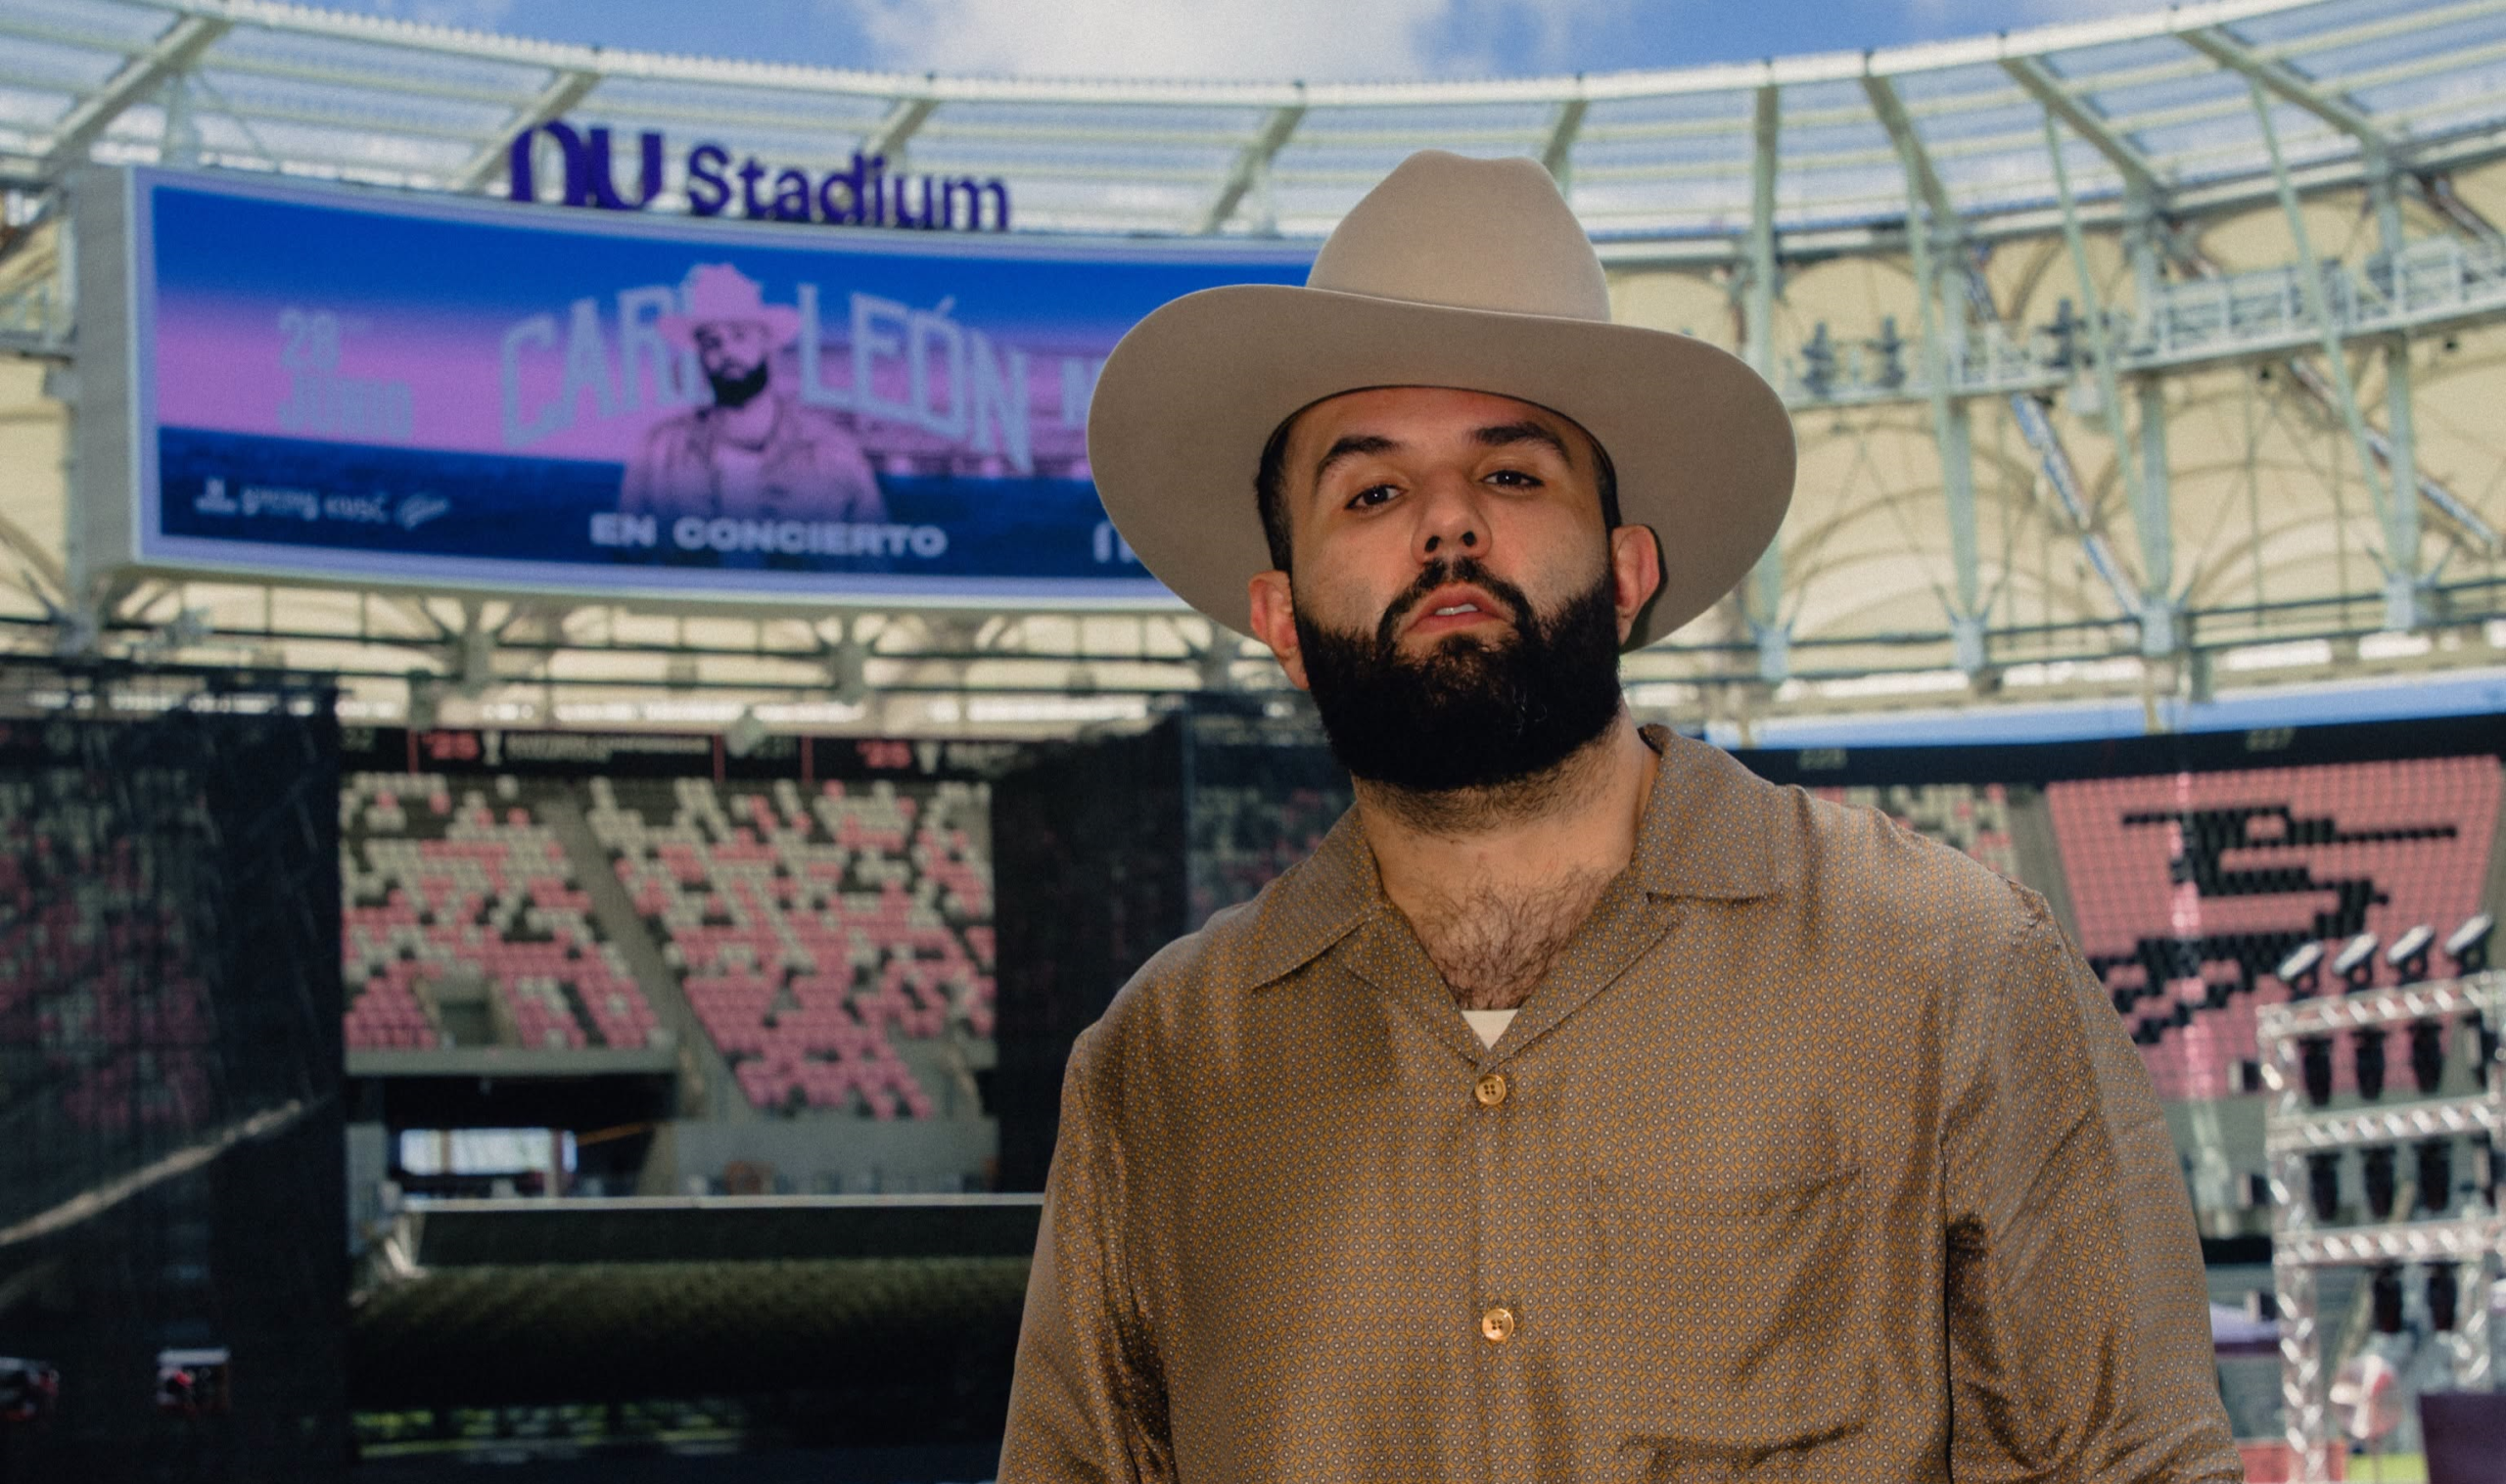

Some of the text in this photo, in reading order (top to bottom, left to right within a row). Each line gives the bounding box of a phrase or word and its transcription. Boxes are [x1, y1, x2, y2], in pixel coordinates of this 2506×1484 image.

[686, 144, 1008, 232] Stadium
[797, 283, 1034, 475] LEÓN
[589, 513, 948, 559] EN CONCIERTO
